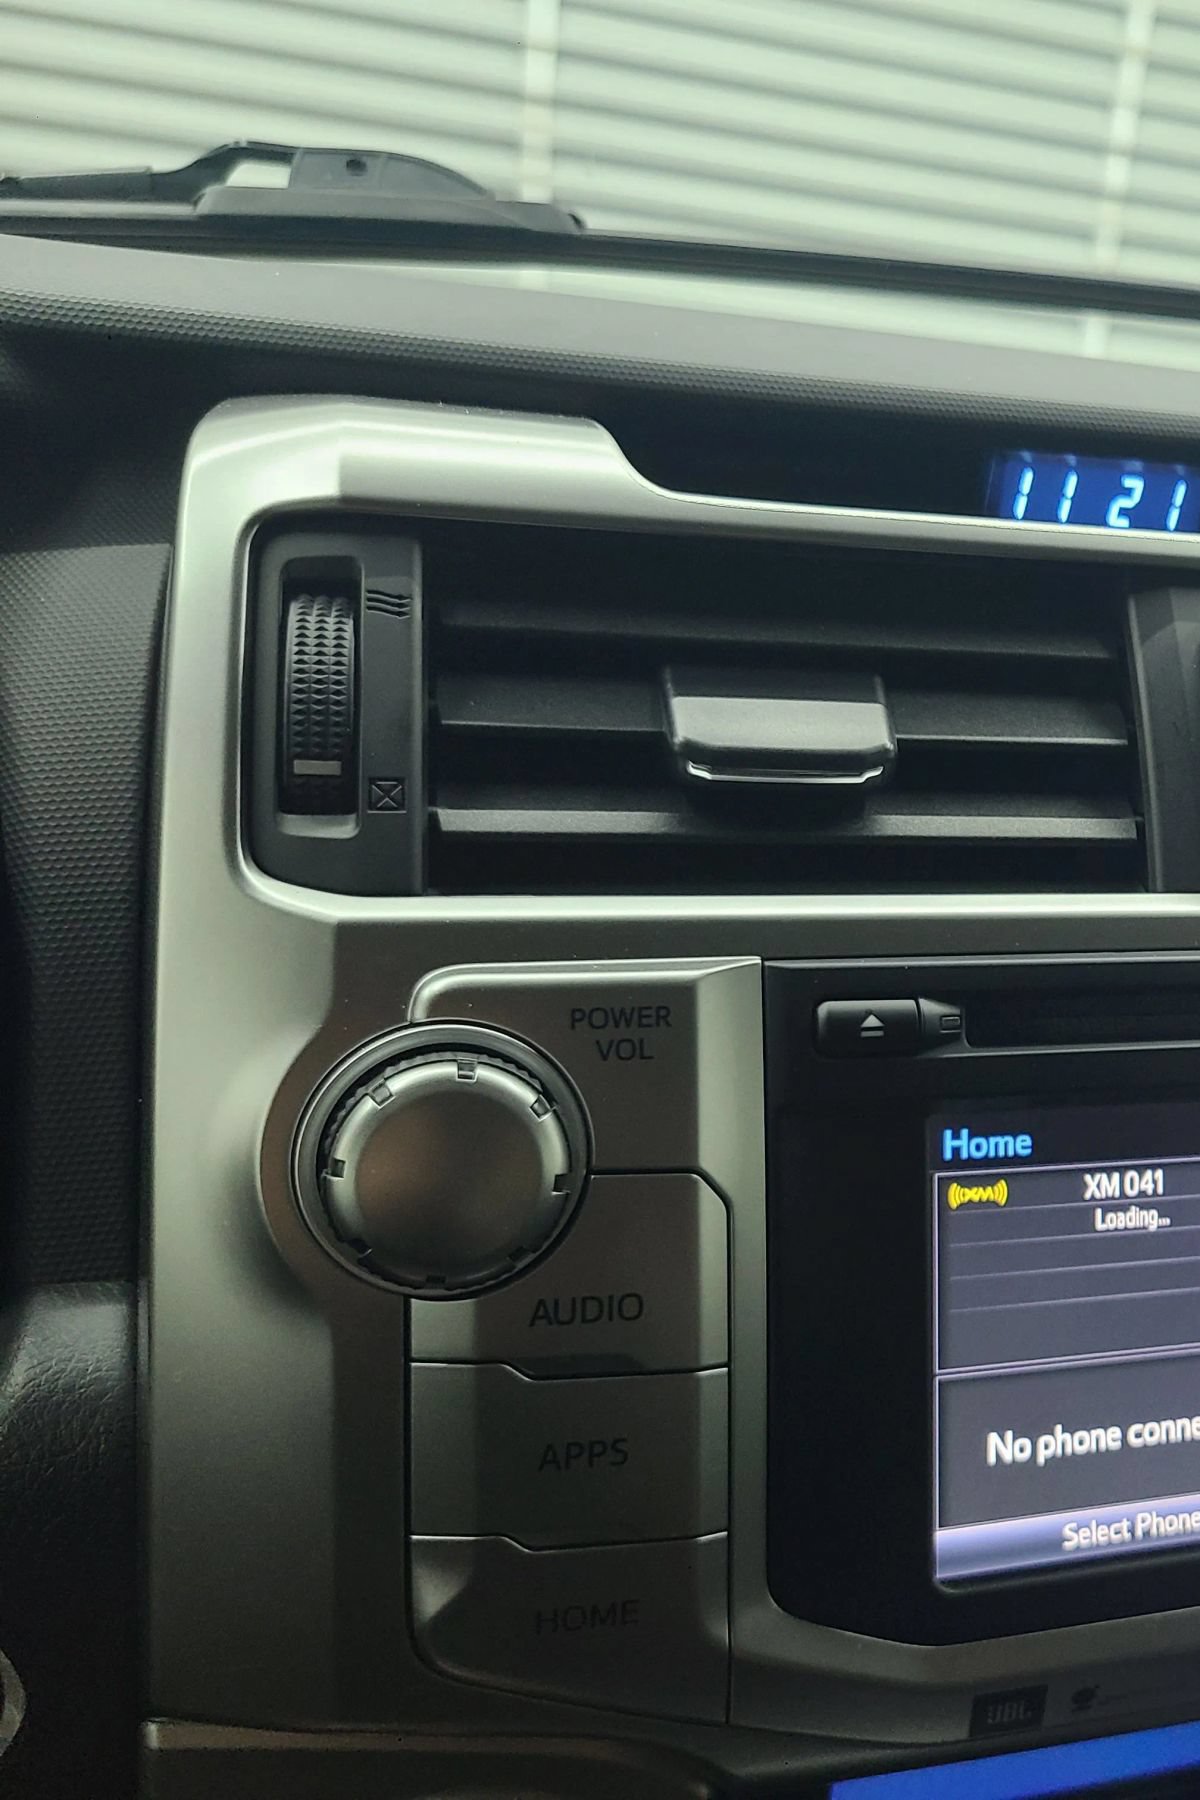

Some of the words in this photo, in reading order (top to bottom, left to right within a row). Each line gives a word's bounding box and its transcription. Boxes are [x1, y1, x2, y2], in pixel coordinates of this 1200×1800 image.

[570, 1005, 672, 1031] POWER
[595, 1037, 654, 1062] VOL
[942, 1128, 1033, 1161] Home
[1083, 1172, 1120, 1200] XM
[1126, 1168, 1165, 1198] 041
[1095, 1206, 1171, 1232] Loading...
[528, 1291, 645, 1328] AUDIO
[538, 1438, 630, 1473] APPS
[985, 1430, 1033, 1467] No
[1036, 1424, 1122, 1467] phone
[1061, 1517, 1132, 1551] Select
[535, 1599, 639, 1636] HOME
